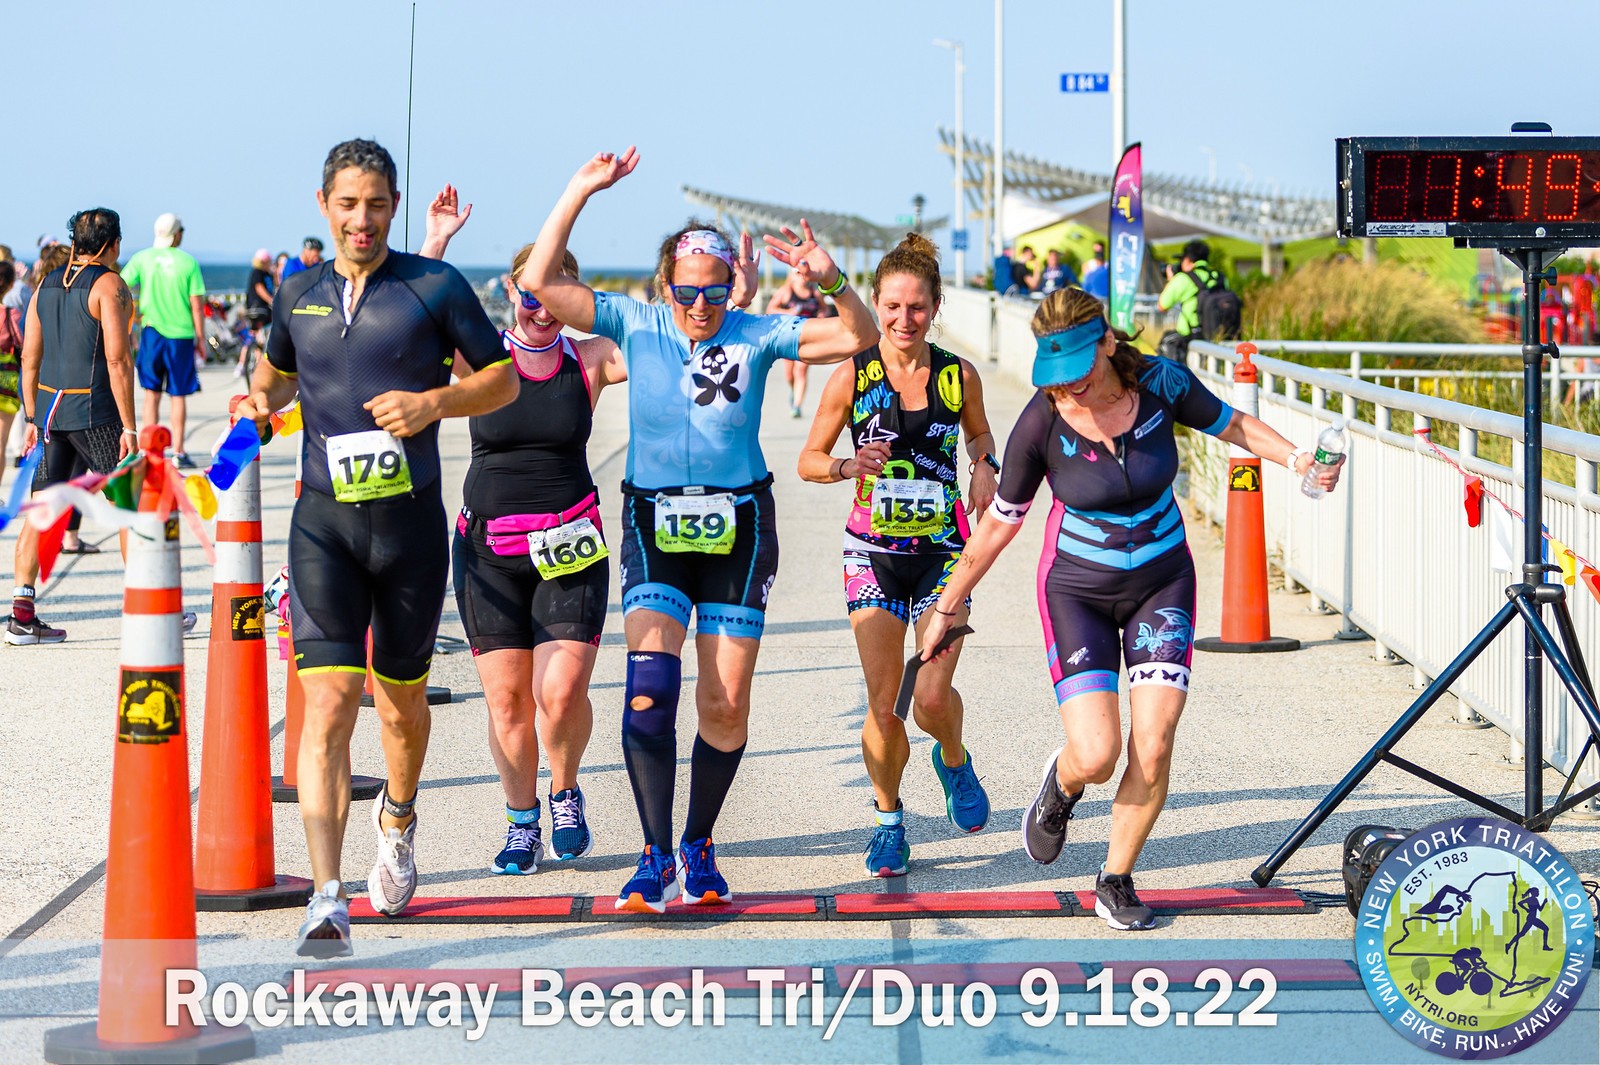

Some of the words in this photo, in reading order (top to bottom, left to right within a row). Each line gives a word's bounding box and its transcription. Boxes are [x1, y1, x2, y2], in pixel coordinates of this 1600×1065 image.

[338, 450, 401, 485] 179
[914, 453, 938, 470] GOOD
[880, 496, 936, 523] 135
[664, 512, 726, 540] 139
[537, 535, 598, 568] 160
